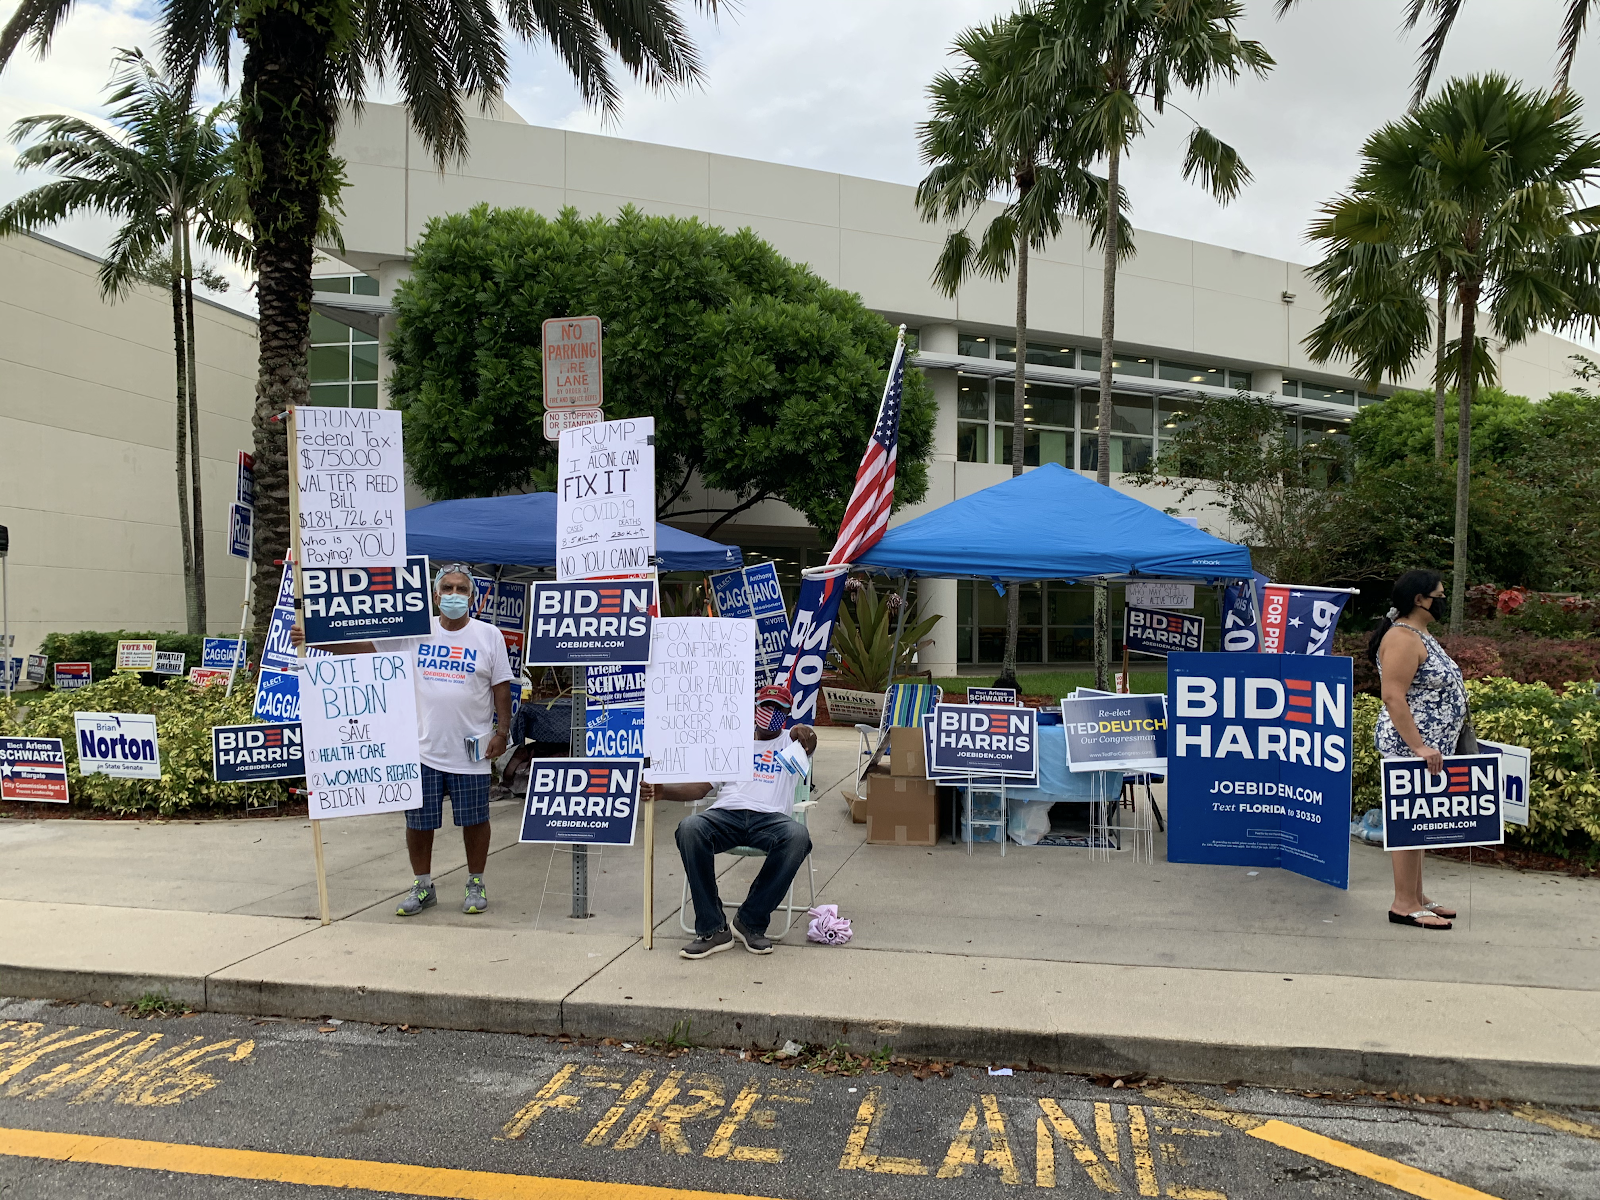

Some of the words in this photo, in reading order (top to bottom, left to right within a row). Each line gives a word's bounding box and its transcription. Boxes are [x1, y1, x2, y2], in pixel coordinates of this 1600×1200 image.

[562, 324, 583, 341] NO
[548, 342, 597, 361] PARKING
[560, 362, 585, 374] FIRE
[557, 374, 589, 387] LANE
[295, 409, 381, 429] TRUMP
[549, 413, 560, 421] NO
[563, 412, 598, 420] STOPPING
[566, 422, 636, 448] TRUMP
[588, 451, 618, 469] ALONE
[621, 449, 640, 465] CAN
[298, 474, 357, 493] WALTER
[366, 475, 398, 493] REED
[564, 473, 598, 502] FIX
[566, 524, 583, 533] CASES
[618, 517, 642, 526] DEATHS
[352, 532, 396, 558] YOU
[561, 556, 575, 577] NO
[582, 550, 605, 571] YOU
[611, 546, 652, 569] CANNOT
[303, 565, 422, 596] BIDEN
[716, 575, 732, 590] ELECT
[305, 592, 425, 618] HARRIS
[538, 588, 648, 614] BIDEN
[1267, 596, 1283, 624] FOR
[328, 616, 404, 629] JOEBIDEN.COM
[536, 615, 647, 638] HARRIS
[770, 616, 785, 624] VOTE
[1130, 611, 1199, 635] BIDEN
[655, 622, 690, 641] FOX
[700, 622, 748, 642] NEWS
[1129, 626, 1198, 648] HARRIS
[418, 643, 477, 661] BIDEN
[556, 640, 625, 649] JOEBIDEN.COM
[1142, 640, 1184, 651] JOEBIDEN.COM
[304, 658, 360, 686] VOTE
[372, 656, 407, 681] FOR
[417, 657, 476, 673] HARRIS
[587, 664, 622, 676] Arlene
[658, 660, 698, 675] TRUMP
[706, 660, 745, 676] TALKING
[262, 676, 283, 688] ELECT
[423, 671, 465, 679] JOEBIDEN.COM
[588, 672, 645, 694] SCHWAR
[652, 677, 671, 694] OF
[678, 676, 703, 693] OUR
[707, 676, 744, 694] FALLEN
[322, 683, 387, 719] BIDEN
[667, 694, 713, 712] HEROES
[722, 695, 738, 713] AS
[969, 694, 1015, 703] SCHWARTZ
[1176, 676, 1346, 729] BIDEN
[719, 715, 741, 730] AND
[941, 712, 1030, 734] BIDEN
[1098, 709, 1131, 718] Re-elect
[96, 723, 117, 732] Brian
[339, 724, 371, 742] SAVE
[26, 741, 52, 750] Arlene
[80, 729, 155, 760] Norton
[218, 728, 301, 750] BIDEN
[586, 729, 645, 756] CAGGIA
[940, 732, 1031, 753] HARRIS
[1080, 737, 1098, 745] Our
[1099, 735, 1156, 745] Congressman
[1176, 724, 1346, 772] HARRIS
[0, 749, 63, 762] SCHWARTZ
[219, 745, 303, 765] HARRIS
[650, 747, 689, 772] WHAT
[705, 747, 745, 771] NEXT
[957, 751, 1013, 760] JOEBIDEN.COM
[235, 762, 288, 772] JOEBIDEN.COM
[386, 763, 419, 782] RIGHTS
[534, 768, 634, 794] BIDEN
[1389, 765, 1495, 795] BIDEN
[319, 787, 366, 810] BIDEN
[378, 782, 412, 804] 2020
[1210, 780, 1323, 806] JOEBIDEN.COM
[530, 796, 631, 818] HARRIS
[1212, 803, 1236, 811] Text
[1239, 803, 1286, 815] FLORIDA
[1288, 808, 1295, 817] to
[1295, 810, 1322, 824] 30330
[1390, 794, 1496, 820] HARRIS
[546, 820, 609, 829] JOEBIDEN.COM
[1412, 820, 1477, 831] JOEBIDEN.COM
[495, 1062, 805, 1165] FIRE
[838, 1085, 1229, 1200] LANE
